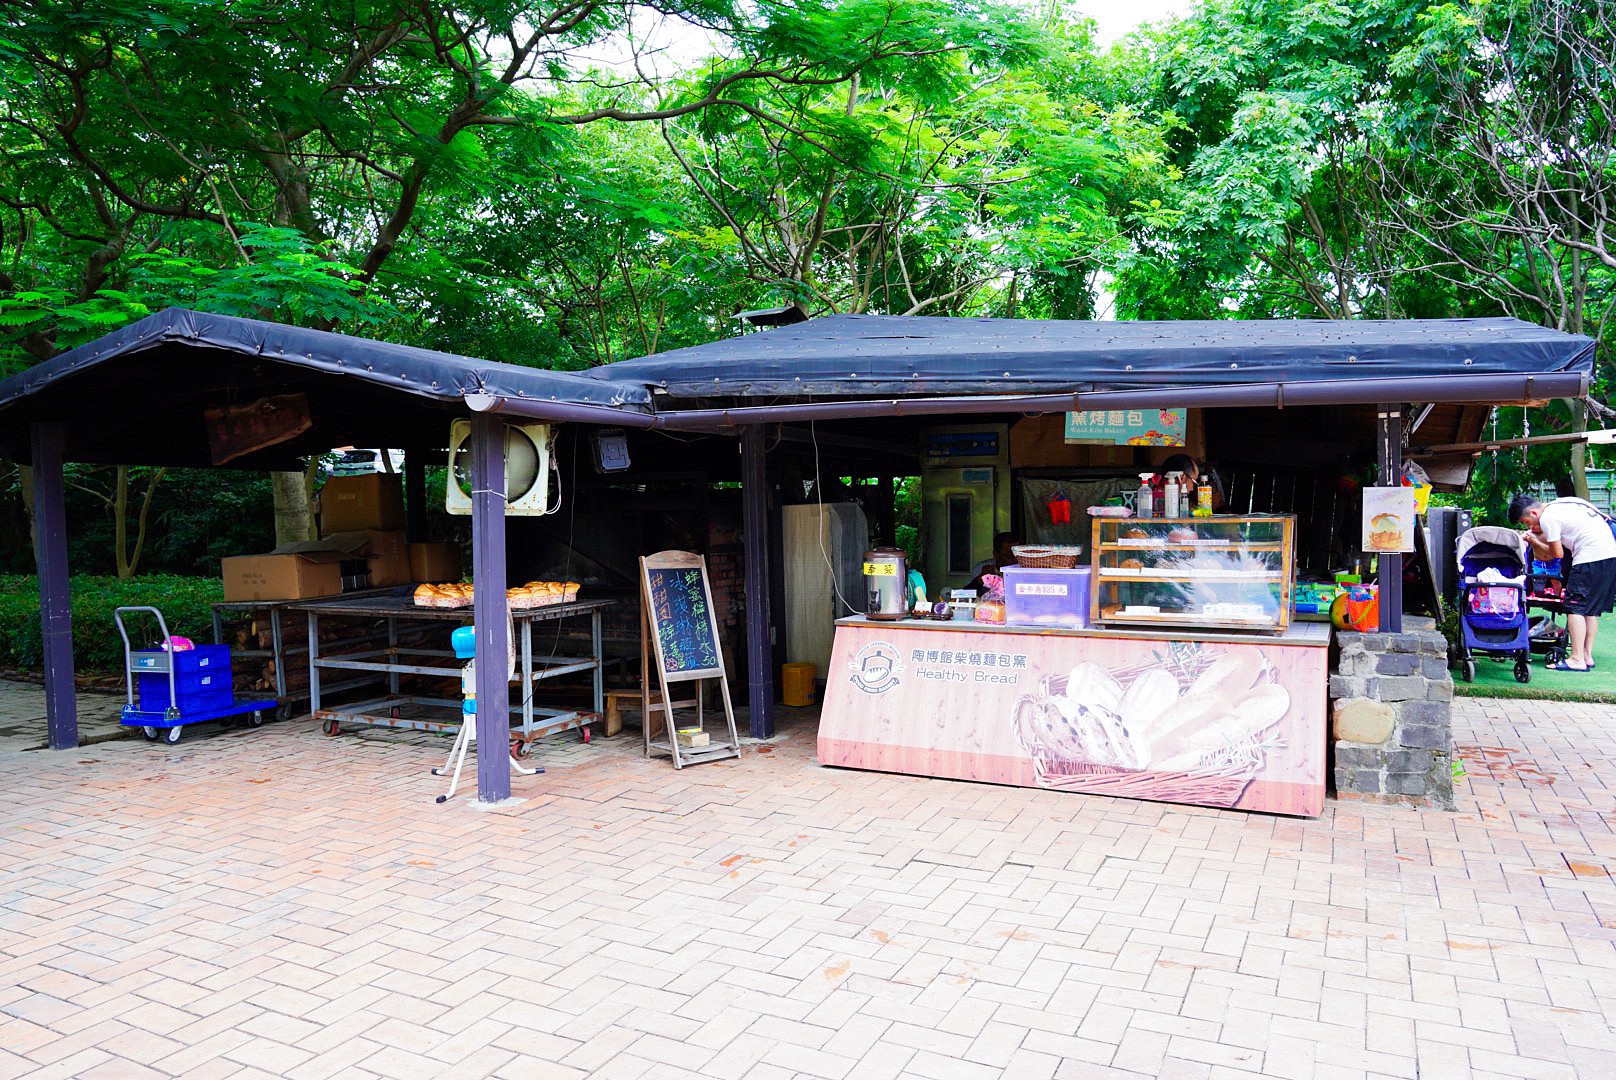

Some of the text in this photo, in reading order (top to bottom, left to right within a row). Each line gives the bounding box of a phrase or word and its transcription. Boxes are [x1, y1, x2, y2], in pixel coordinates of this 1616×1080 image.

[1071, 411, 1144, 426] 窯烤麵包
[701, 656, 716, 666] 50
[911, 649, 1027, 669] 陶博館柴燒麵包窯
[916, 668, 1018, 684] Healthy Bread
